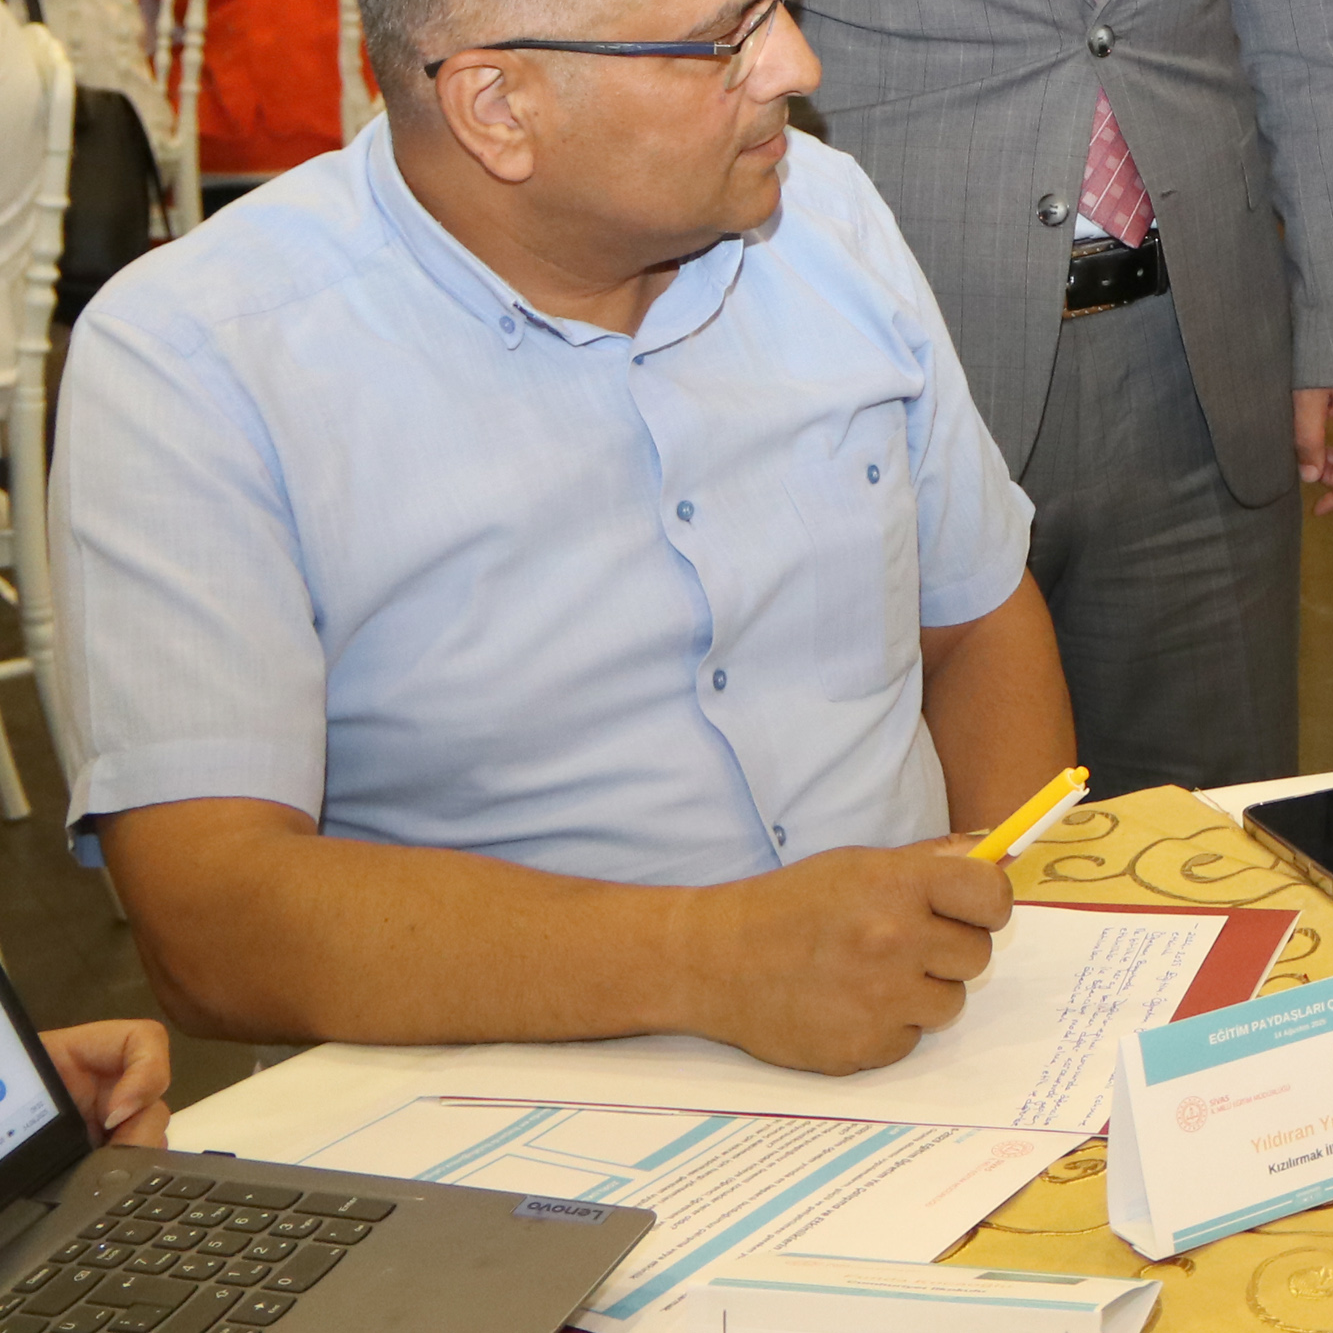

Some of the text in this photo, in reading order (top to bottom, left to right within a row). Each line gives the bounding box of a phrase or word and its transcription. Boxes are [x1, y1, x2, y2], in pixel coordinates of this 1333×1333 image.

[1208, 1023, 1250, 1046] EĞİTİM
[1251, 1002, 1326, 1033] PAYDAŞLARI
[1251, 1122, 1315, 1154] Yıldıran
[1268, 1147, 1324, 1175] Kızılırmak
[527, 1201, 604, 1221] Lenovo
[279, 1223, 294, 1231] 3
[163, 1234, 177, 1242] 8
[209, 1240, 223, 1248] 5
[253, 1246, 268, 1255] 2
